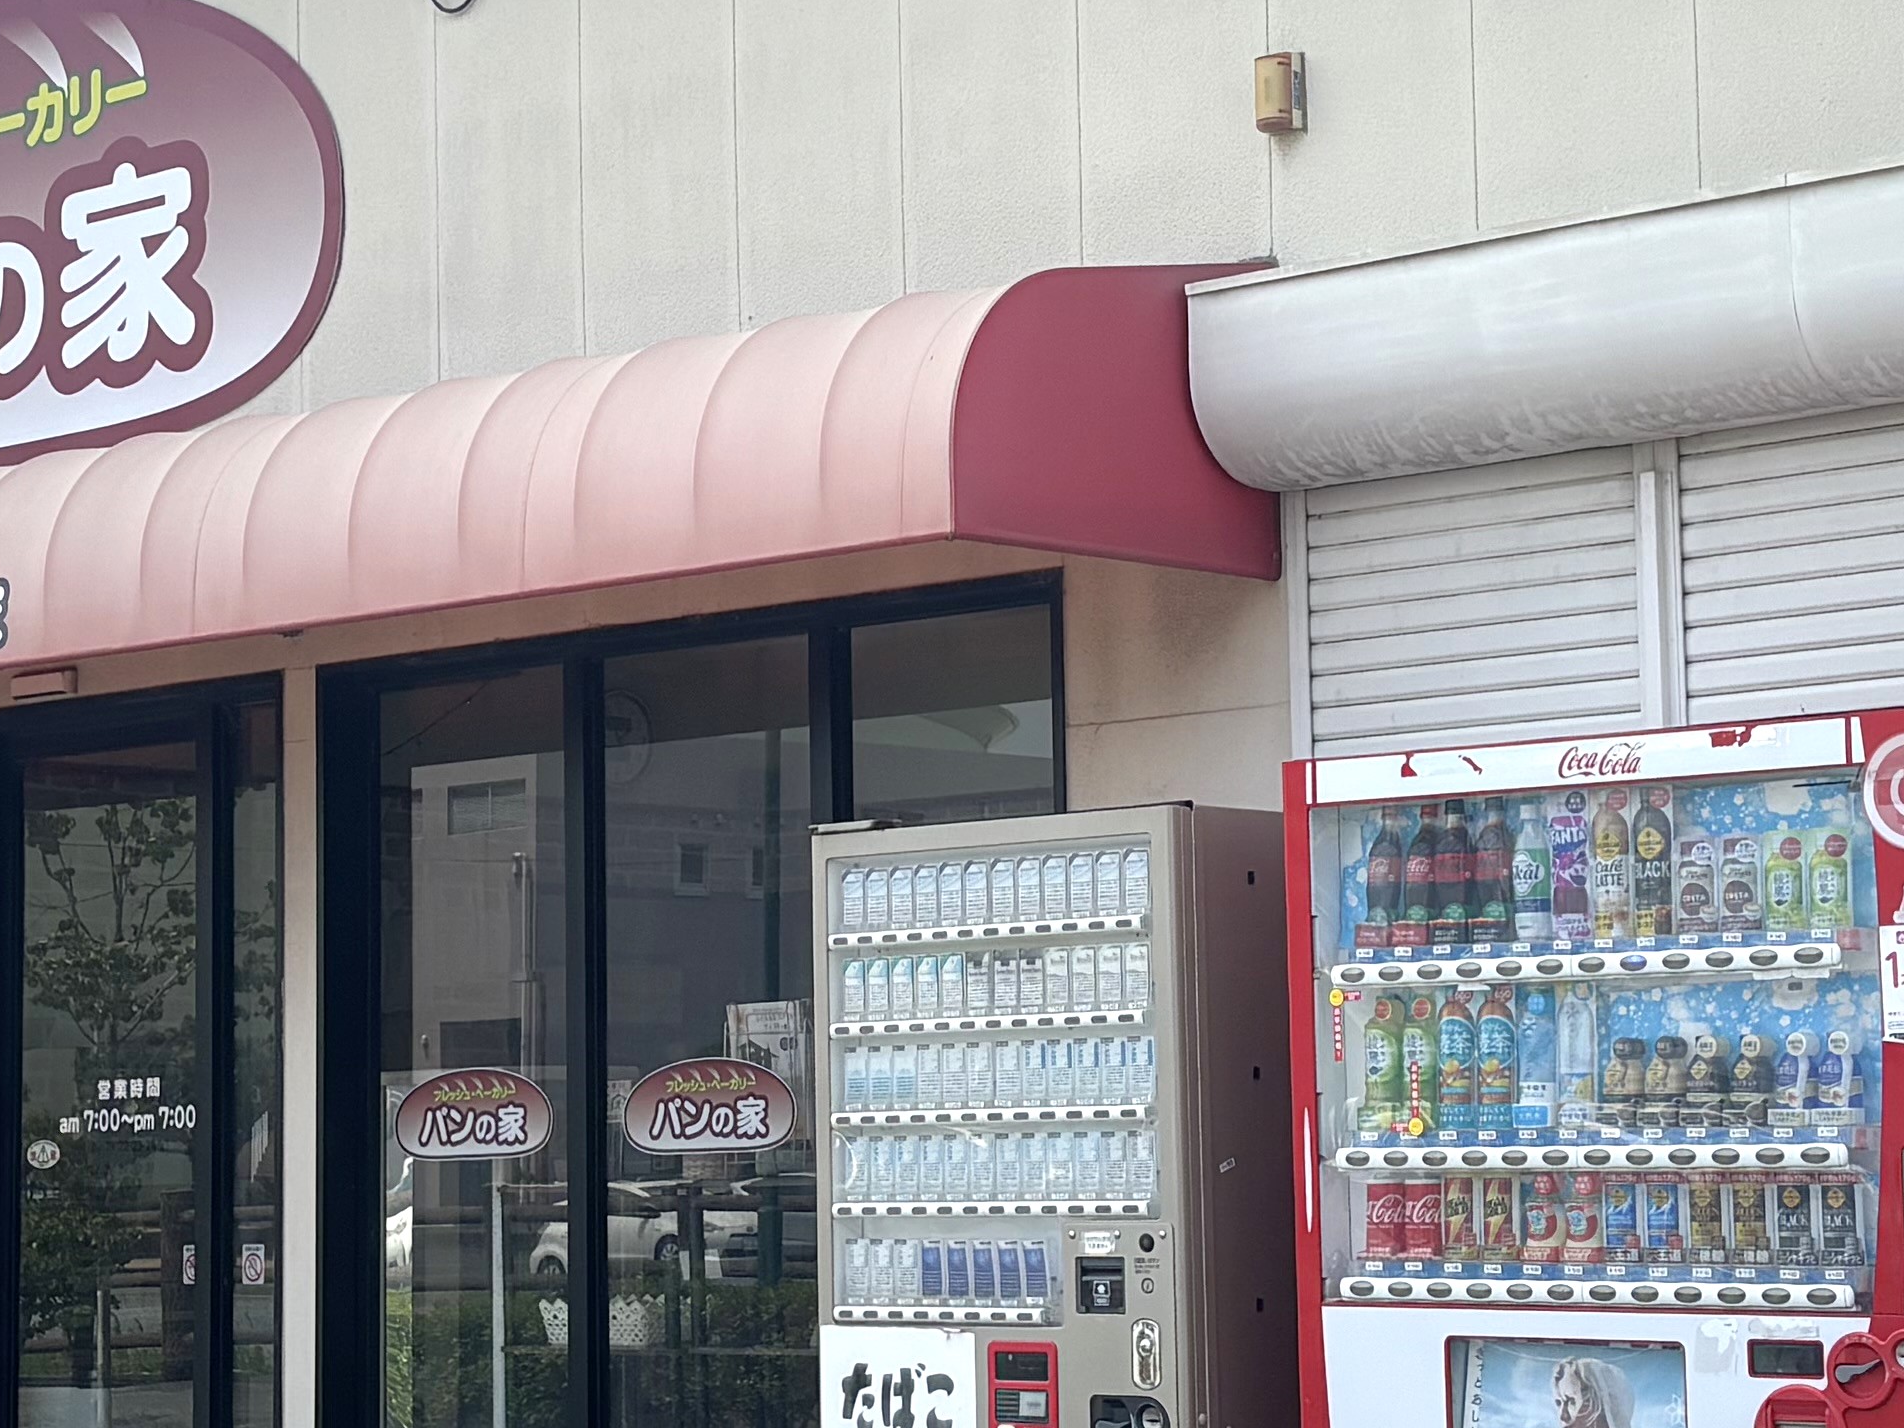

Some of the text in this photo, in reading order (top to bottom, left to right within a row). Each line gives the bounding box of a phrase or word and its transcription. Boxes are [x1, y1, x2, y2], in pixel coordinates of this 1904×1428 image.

[97, 1076, 161, 1100] 営業時間
[59, 1116, 80, 1134] am
[158, 1104, 196, 1130] 7:00
[420, 1104, 525, 1144] パンの家
[651, 1096, 767, 1137] パンの家
